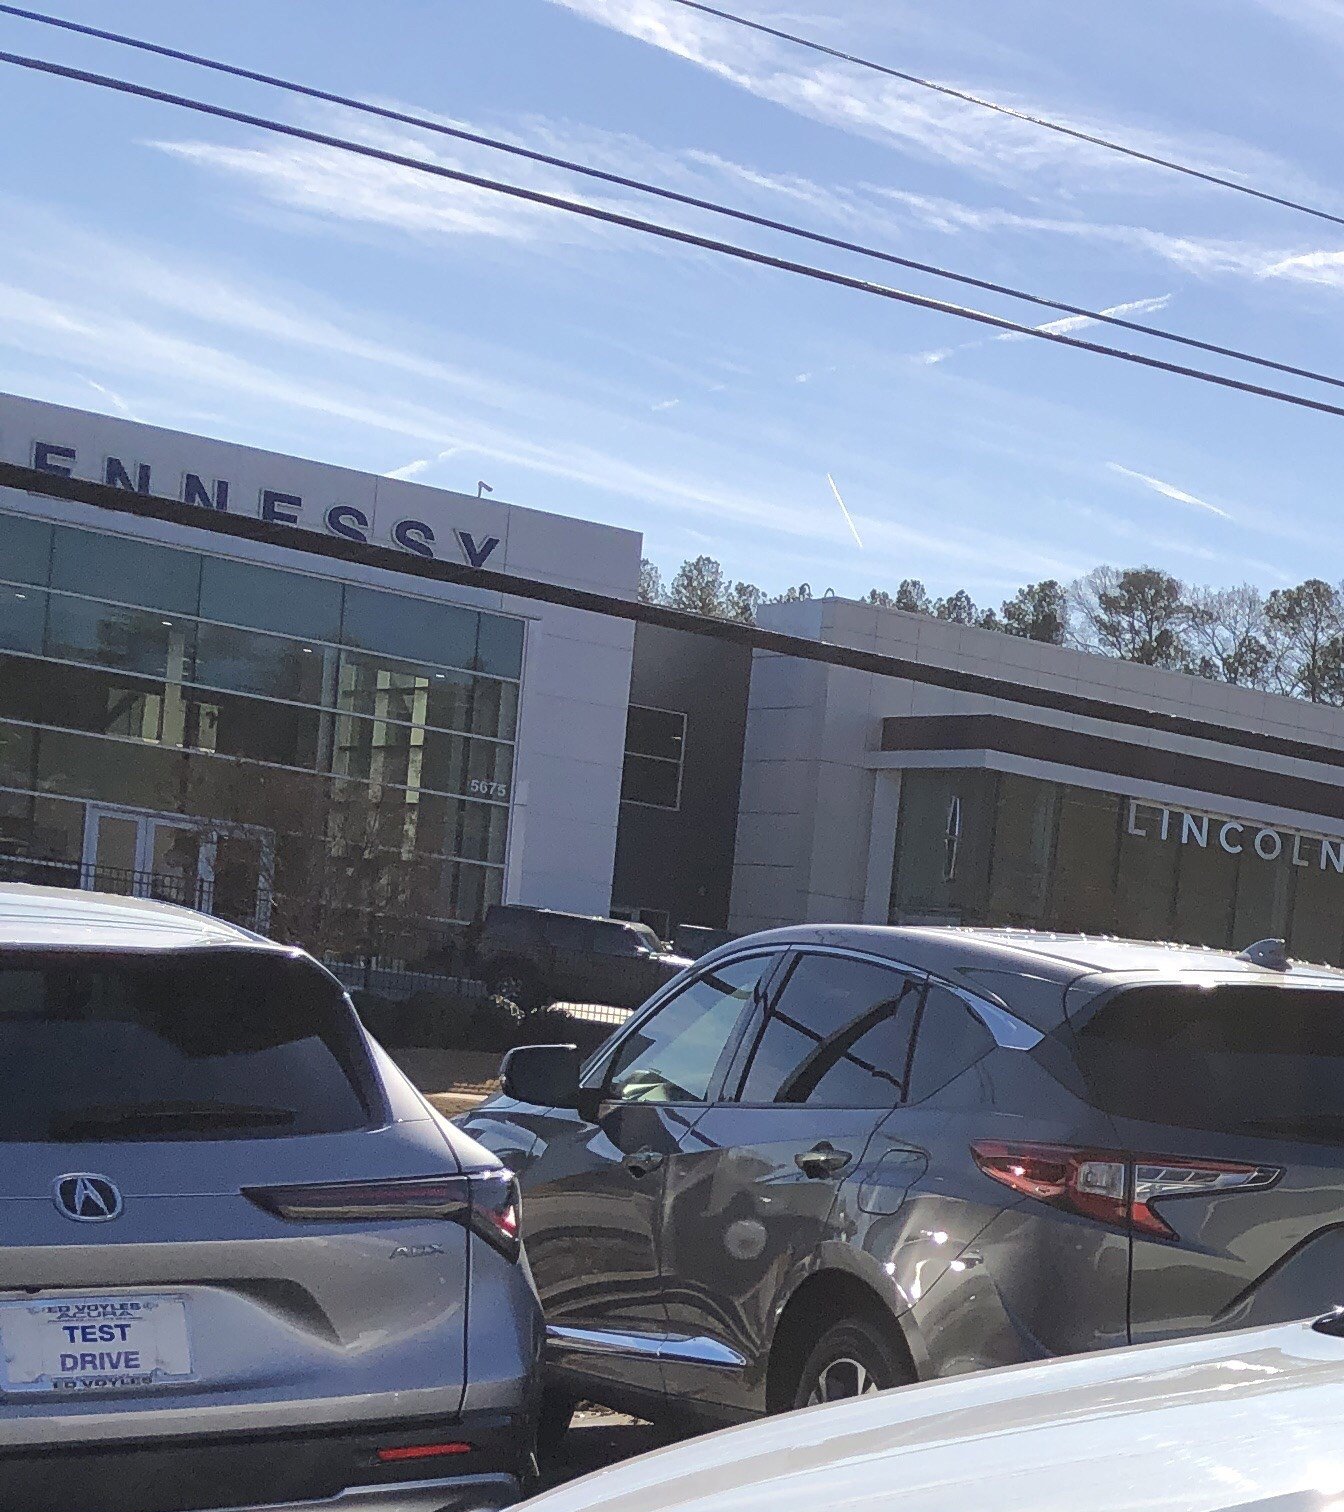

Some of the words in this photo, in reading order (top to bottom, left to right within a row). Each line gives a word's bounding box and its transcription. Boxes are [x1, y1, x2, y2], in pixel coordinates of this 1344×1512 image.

[470, 779, 507, 797] 5675
[62, 1323, 132, 1344] TEST
[60, 1350, 141, 1372] DRIVE
